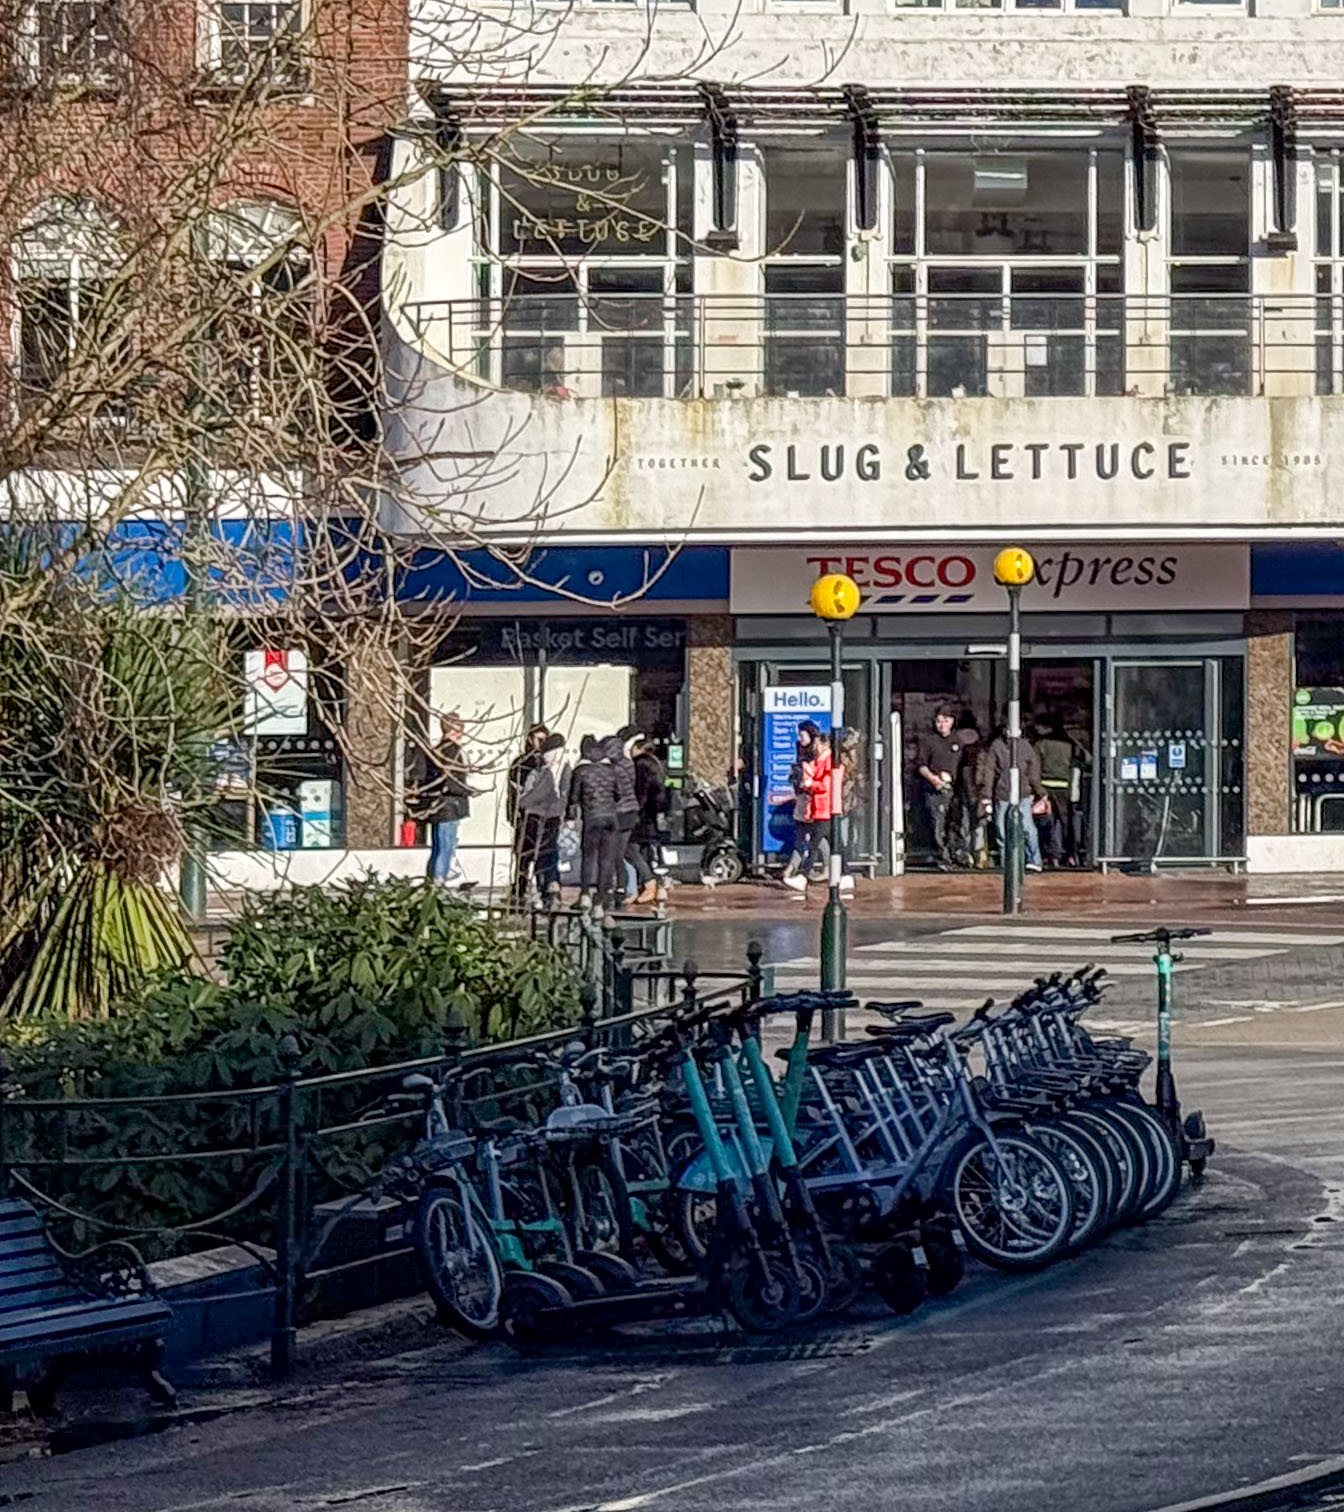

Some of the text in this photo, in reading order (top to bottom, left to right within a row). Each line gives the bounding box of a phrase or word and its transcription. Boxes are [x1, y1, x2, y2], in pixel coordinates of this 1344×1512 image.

[576, 194, 590, 212] &
[638, 457, 720, 469] TOGETHER
[748, 441, 1191, 482] SLUG & LETTUCE
[806, 551, 1178, 599] TESCO xpress
[502, 626, 585, 649] Basket
[591, 626, 639, 649] Self
[774, 686, 825, 707] Hello.
